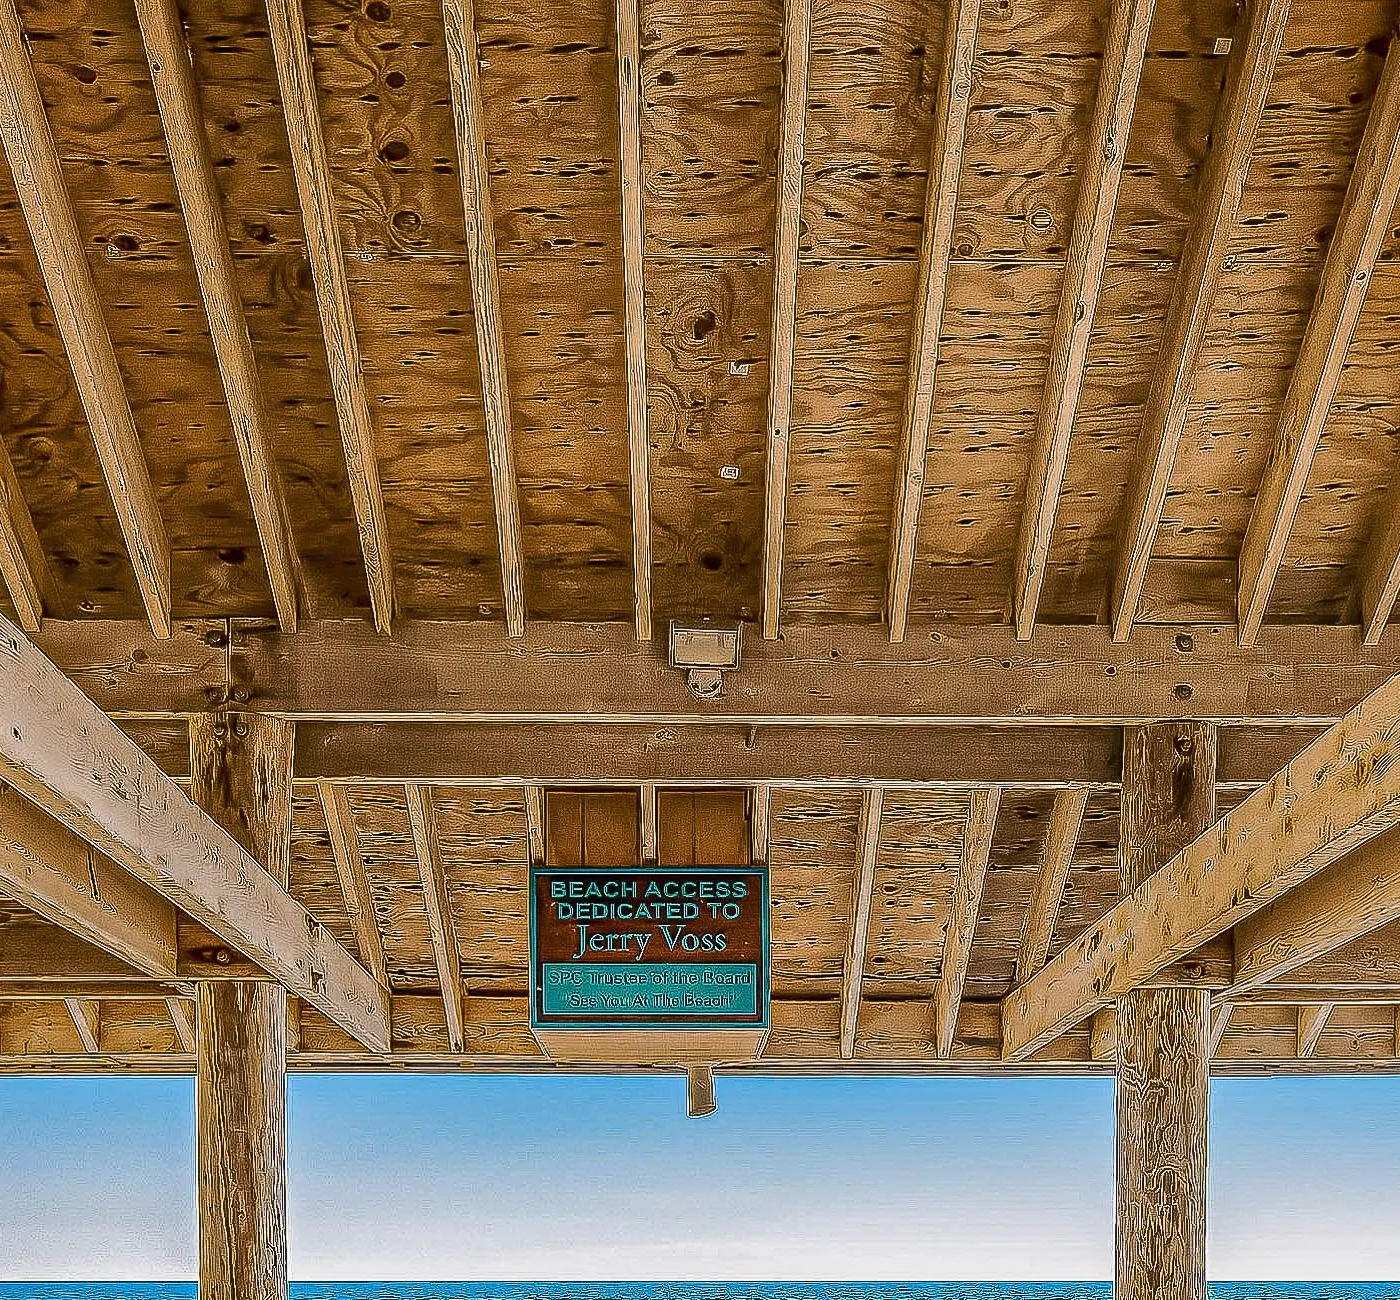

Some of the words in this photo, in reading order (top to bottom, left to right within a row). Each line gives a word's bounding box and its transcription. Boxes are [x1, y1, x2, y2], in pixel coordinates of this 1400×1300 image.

[551, 881, 637, 898] BEACH
[644, 881, 747, 898] ACCESS
[558, 902, 699, 919] DEDICATED
[706, 902, 740, 920] TO
[572, 924, 652, 961] Jerry
[656, 924, 727, 952] Voss
[549, 971, 582, 985] SPC
[587, 971, 647, 985] Trustee
[652, 970, 669, 985] of
[672, 971, 699, 985] the
[703, 970, 752, 985] Board
[600, 993, 631, 1007] You
[632, 993, 649, 1007] At
[653, 993, 680, 1007] The
